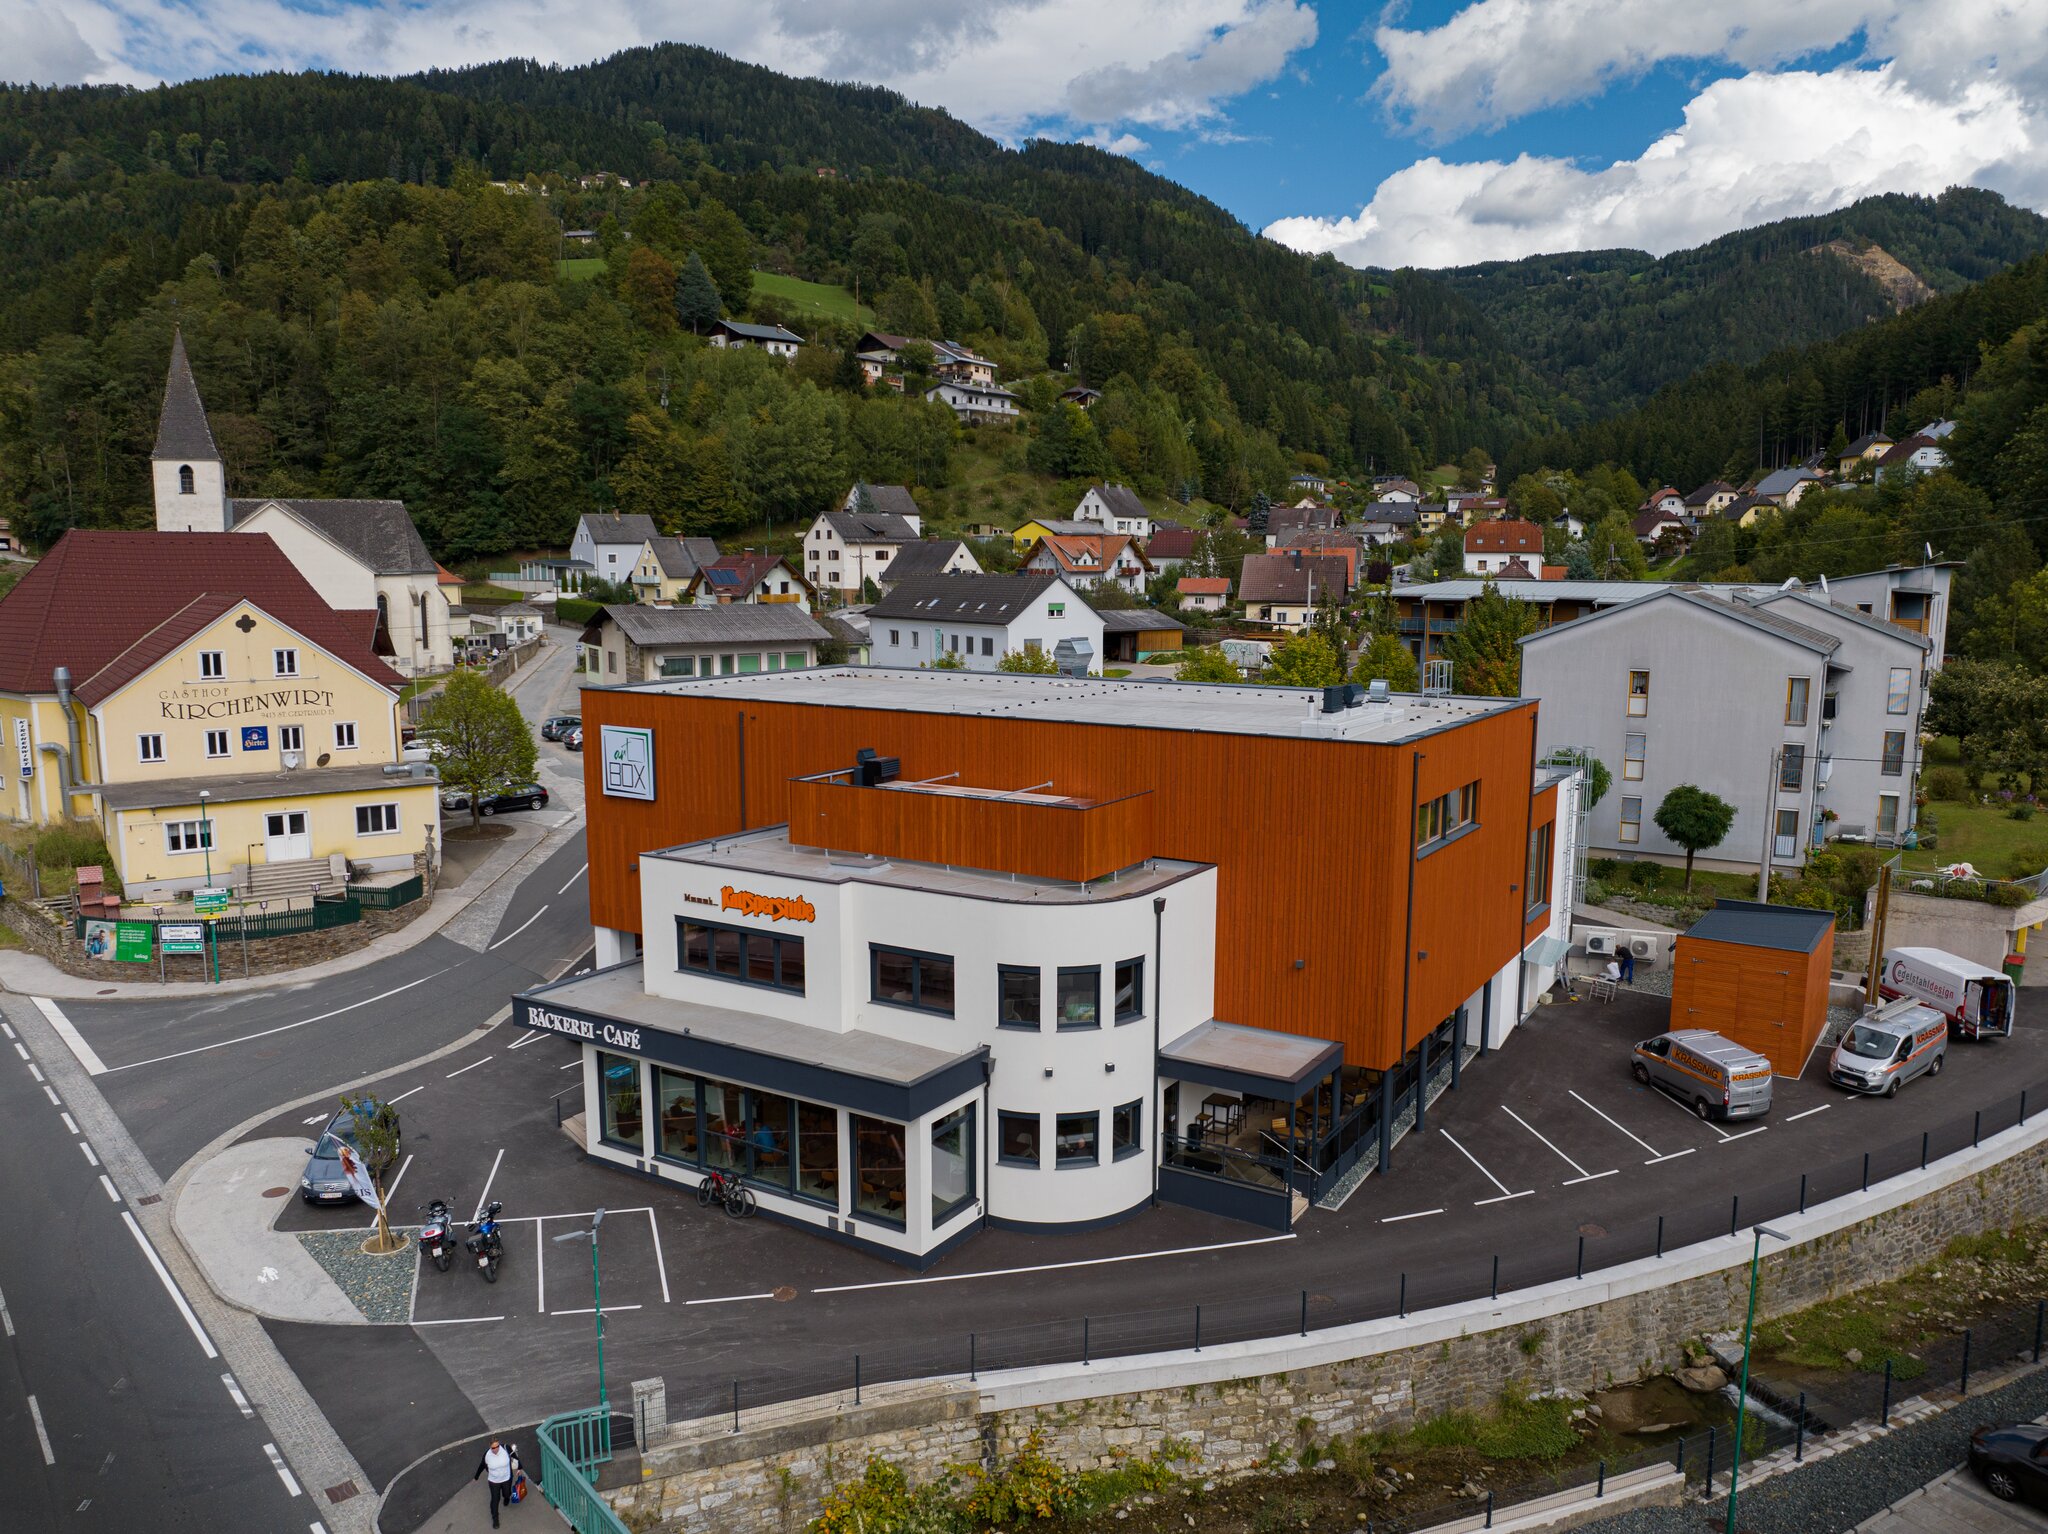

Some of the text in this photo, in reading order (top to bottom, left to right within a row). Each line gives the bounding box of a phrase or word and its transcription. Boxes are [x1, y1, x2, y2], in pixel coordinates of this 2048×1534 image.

[159, 687, 229, 700] GASTHOF
[160, 689, 334, 720] KIRCHENWIRT
[19, 719, 29, 767] KIRCHENWIRT
[609, 762, 646, 789] BOX
[1897, 968, 1954, 999] edelstahldesign
[527, 1007, 595, 1039] BÄCKEREI
[603, 1024, 641, 1050] CAFÉ
[1915, 1022, 1946, 1044] KRASSNIG
[1674, 1048, 1719, 1080] KRASSNIG
[1732, 1069, 1771, 1082] KRASSNIG
